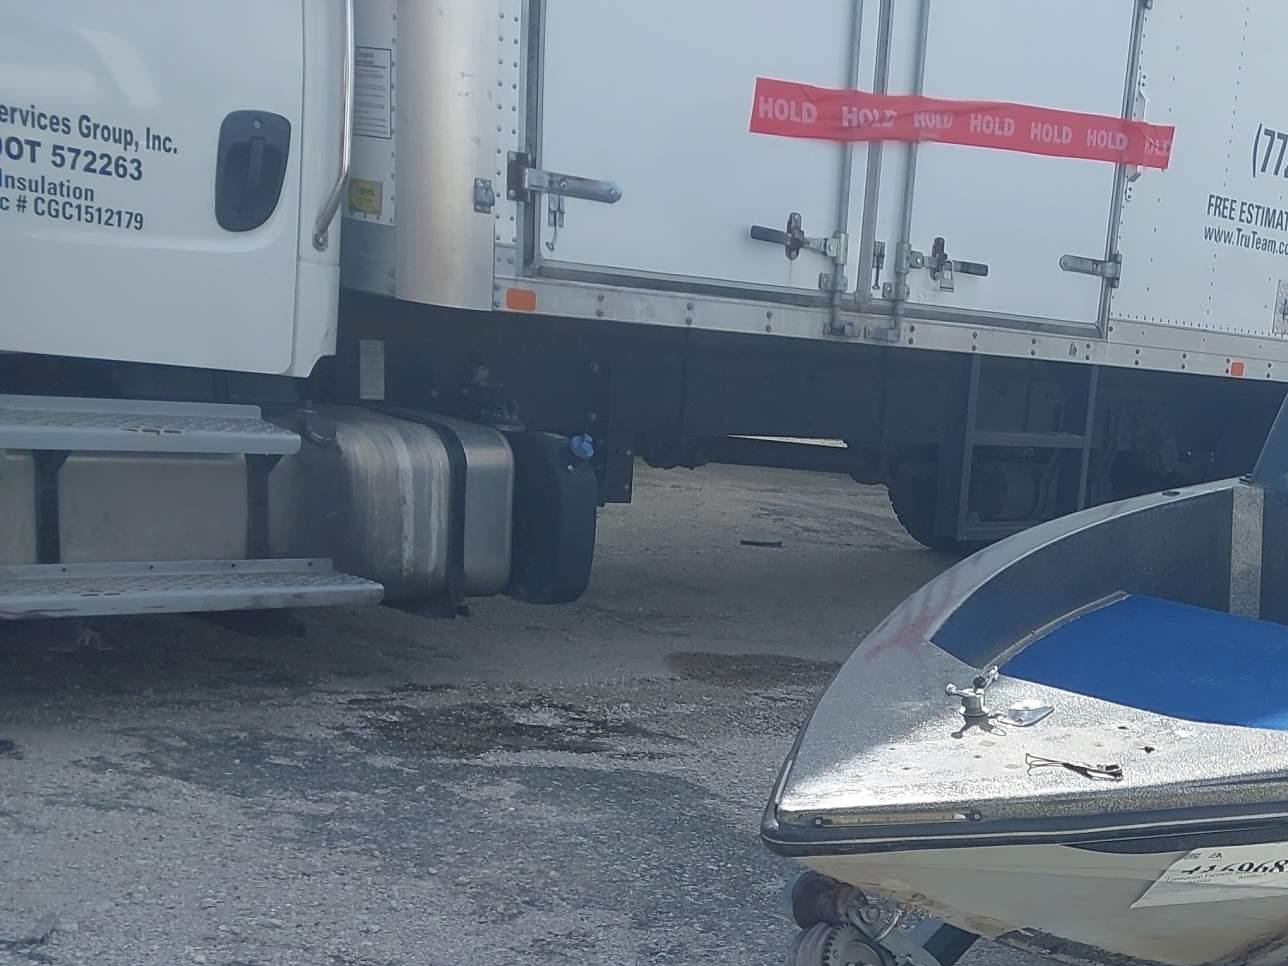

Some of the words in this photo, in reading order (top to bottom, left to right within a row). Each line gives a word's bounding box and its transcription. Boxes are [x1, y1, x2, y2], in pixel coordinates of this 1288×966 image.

[78, 114, 140, 152] Group,
[145, 126, 178, 154] Inc.
[758, 96, 818, 124] HOLD
[841, 106, 898, 128] HOLD
[969, 113, 1015, 137] HOLD
[1030, 121, 1072, 144] HOLD
[1086, 128, 1128, 151] HOLD
[51, 144, 143, 181] 572263
[16, 195, 28, 213] #
[34, 196, 144, 230] CGC1512179
[1206, 194, 1238, 221] FREE
